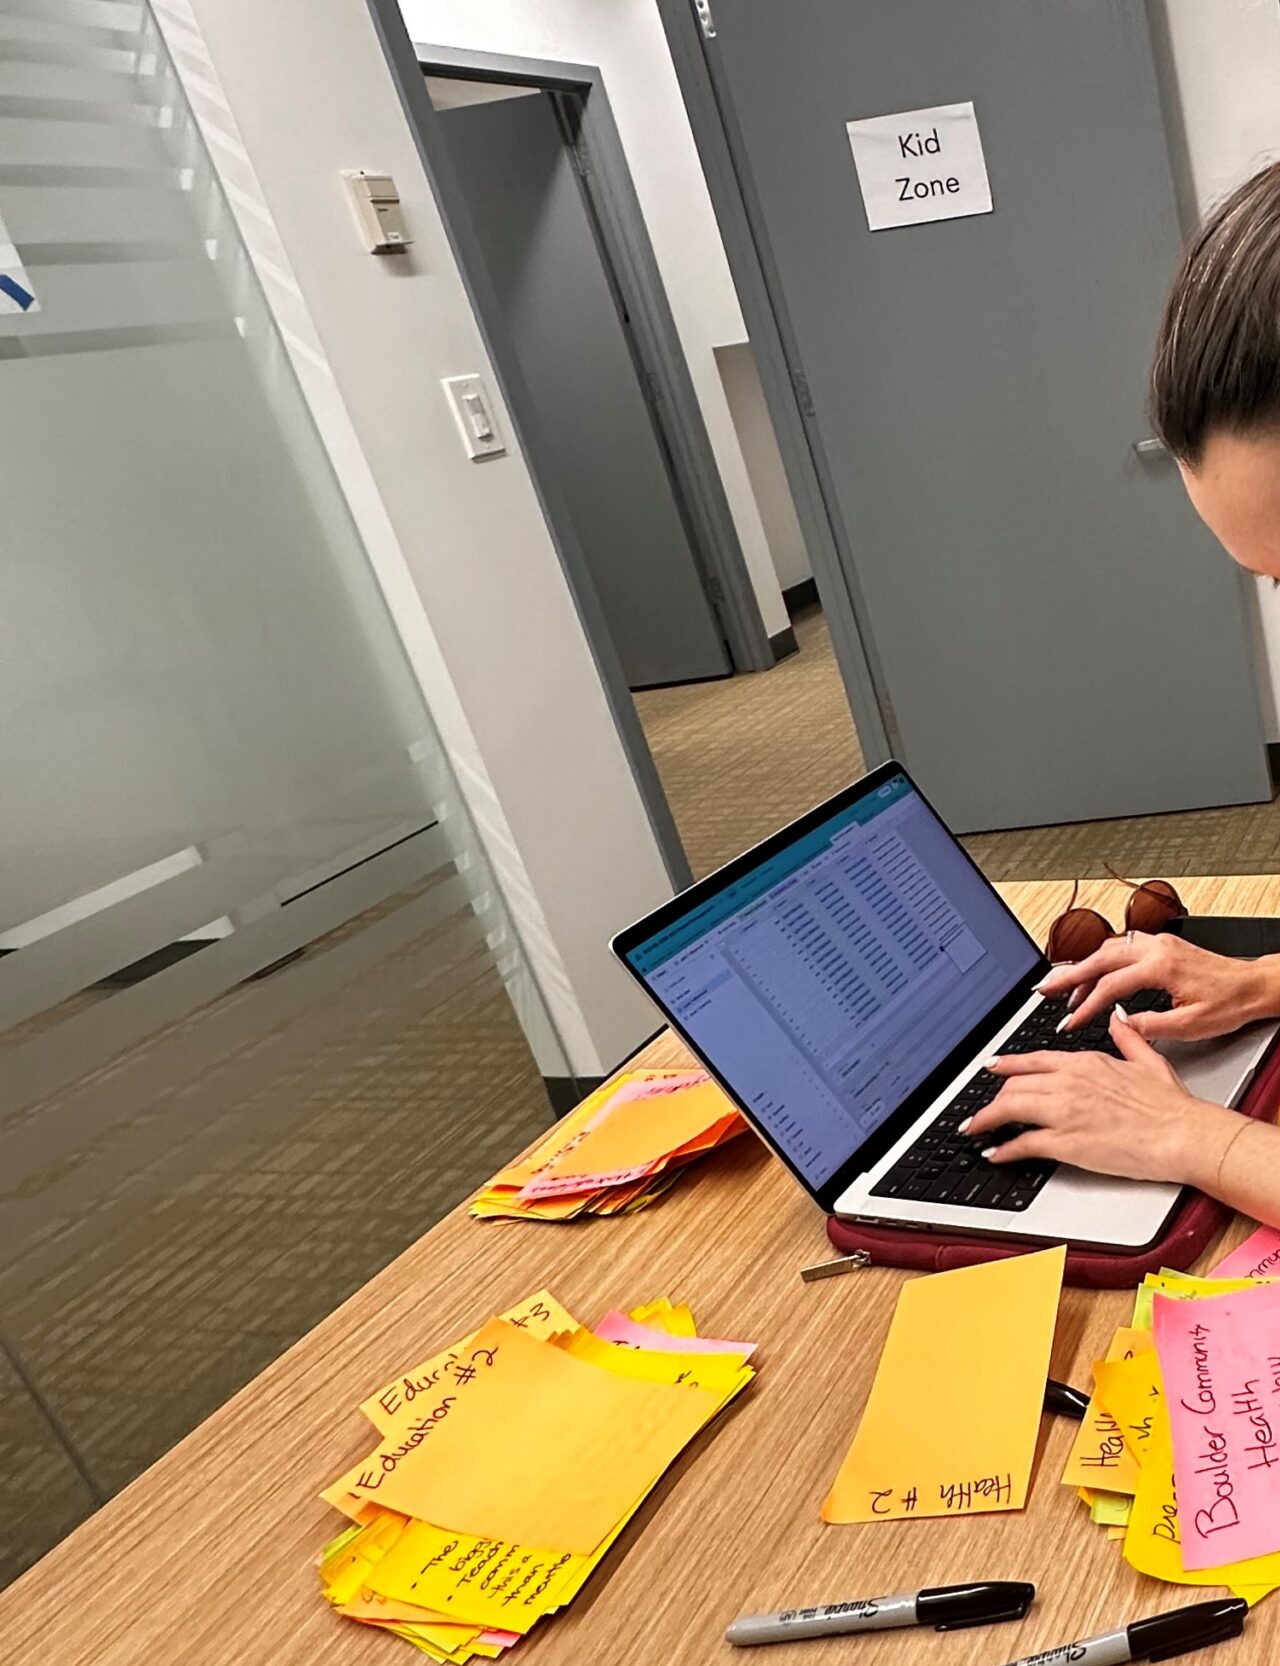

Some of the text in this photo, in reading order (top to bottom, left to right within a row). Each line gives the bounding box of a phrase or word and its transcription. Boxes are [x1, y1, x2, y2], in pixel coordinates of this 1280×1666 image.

[898, 128, 941, 158] Kid
[895, 176, 960, 201] Zone
[1181, 1323, 1215, 1415] Community
[356, 1396, 457, 1490] Education
[1231, 1379, 1279, 1469] Health
[939, 1472, 1012, 1509] Health
[1195, 1426, 1239, 1539] Boulder
[421, 1541, 459, 1575] The
